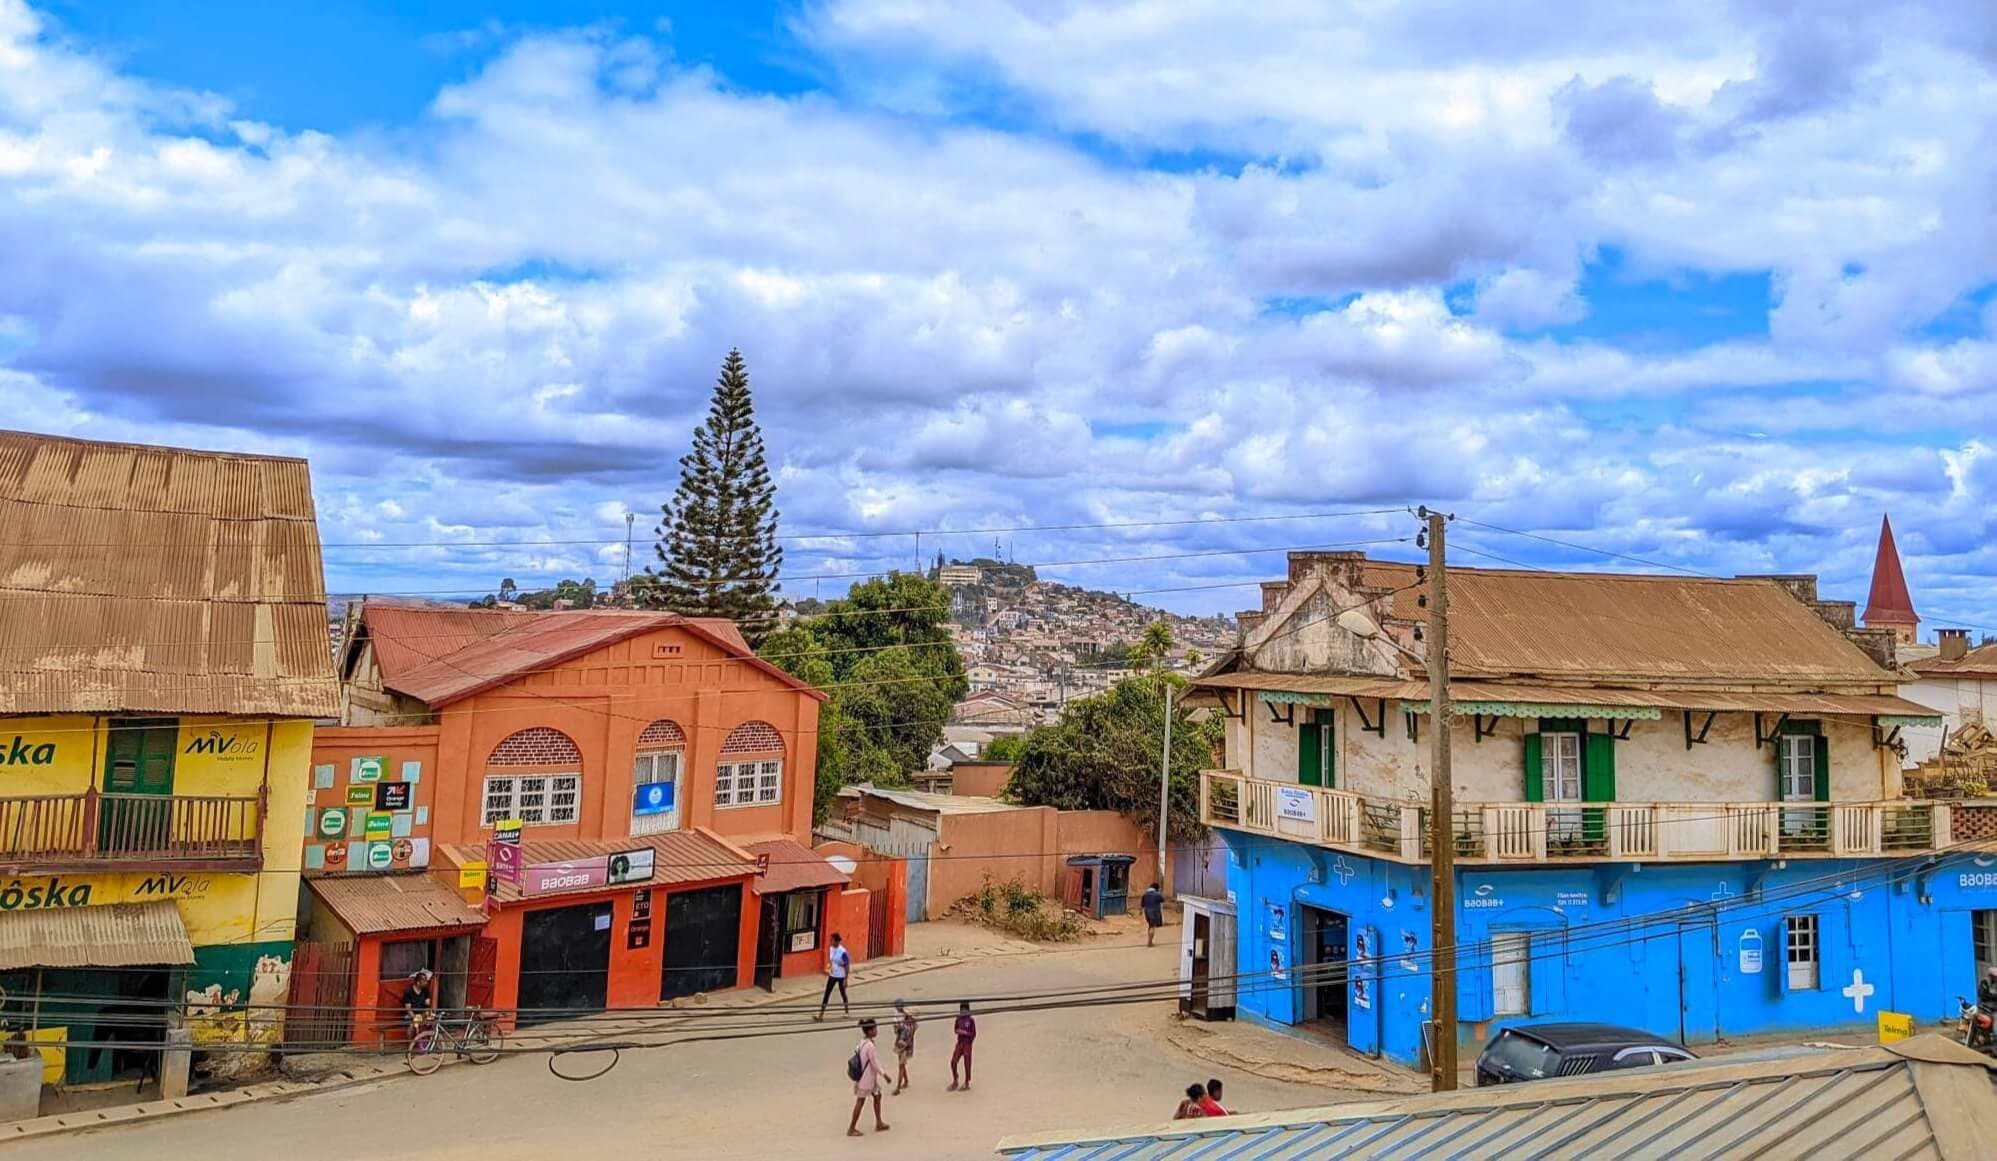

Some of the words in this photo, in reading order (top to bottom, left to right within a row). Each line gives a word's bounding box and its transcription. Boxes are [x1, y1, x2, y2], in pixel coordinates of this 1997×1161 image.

[185, 733, 259, 753] MVola
[495, 831, 520, 840] CANAL+
[135, 876, 210, 895] MVola
[1884, 1024, 1907, 1036] Telma
